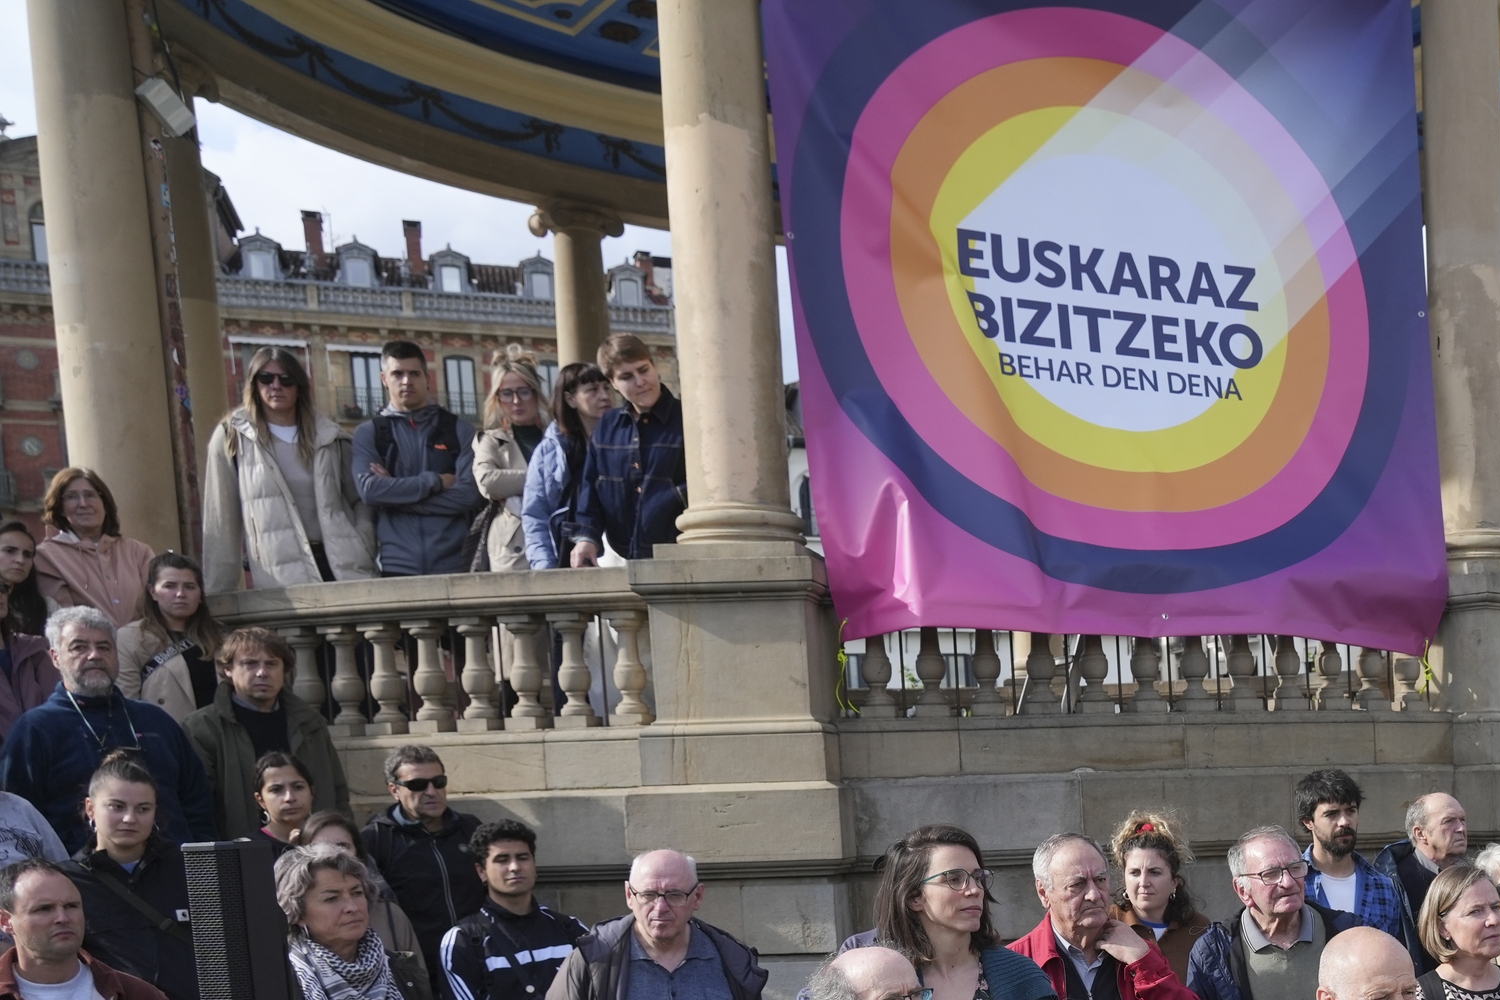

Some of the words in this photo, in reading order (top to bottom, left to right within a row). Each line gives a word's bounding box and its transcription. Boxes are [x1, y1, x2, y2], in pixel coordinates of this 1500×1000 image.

[956, 227, 1259, 312] EUSKARAZ
[966, 289, 1263, 370] BIZITZEKO
[998, 352, 1093, 386] BEHAR
[1101, 364, 1159, 393] DEN
[1166, 371, 1243, 400] DENA
